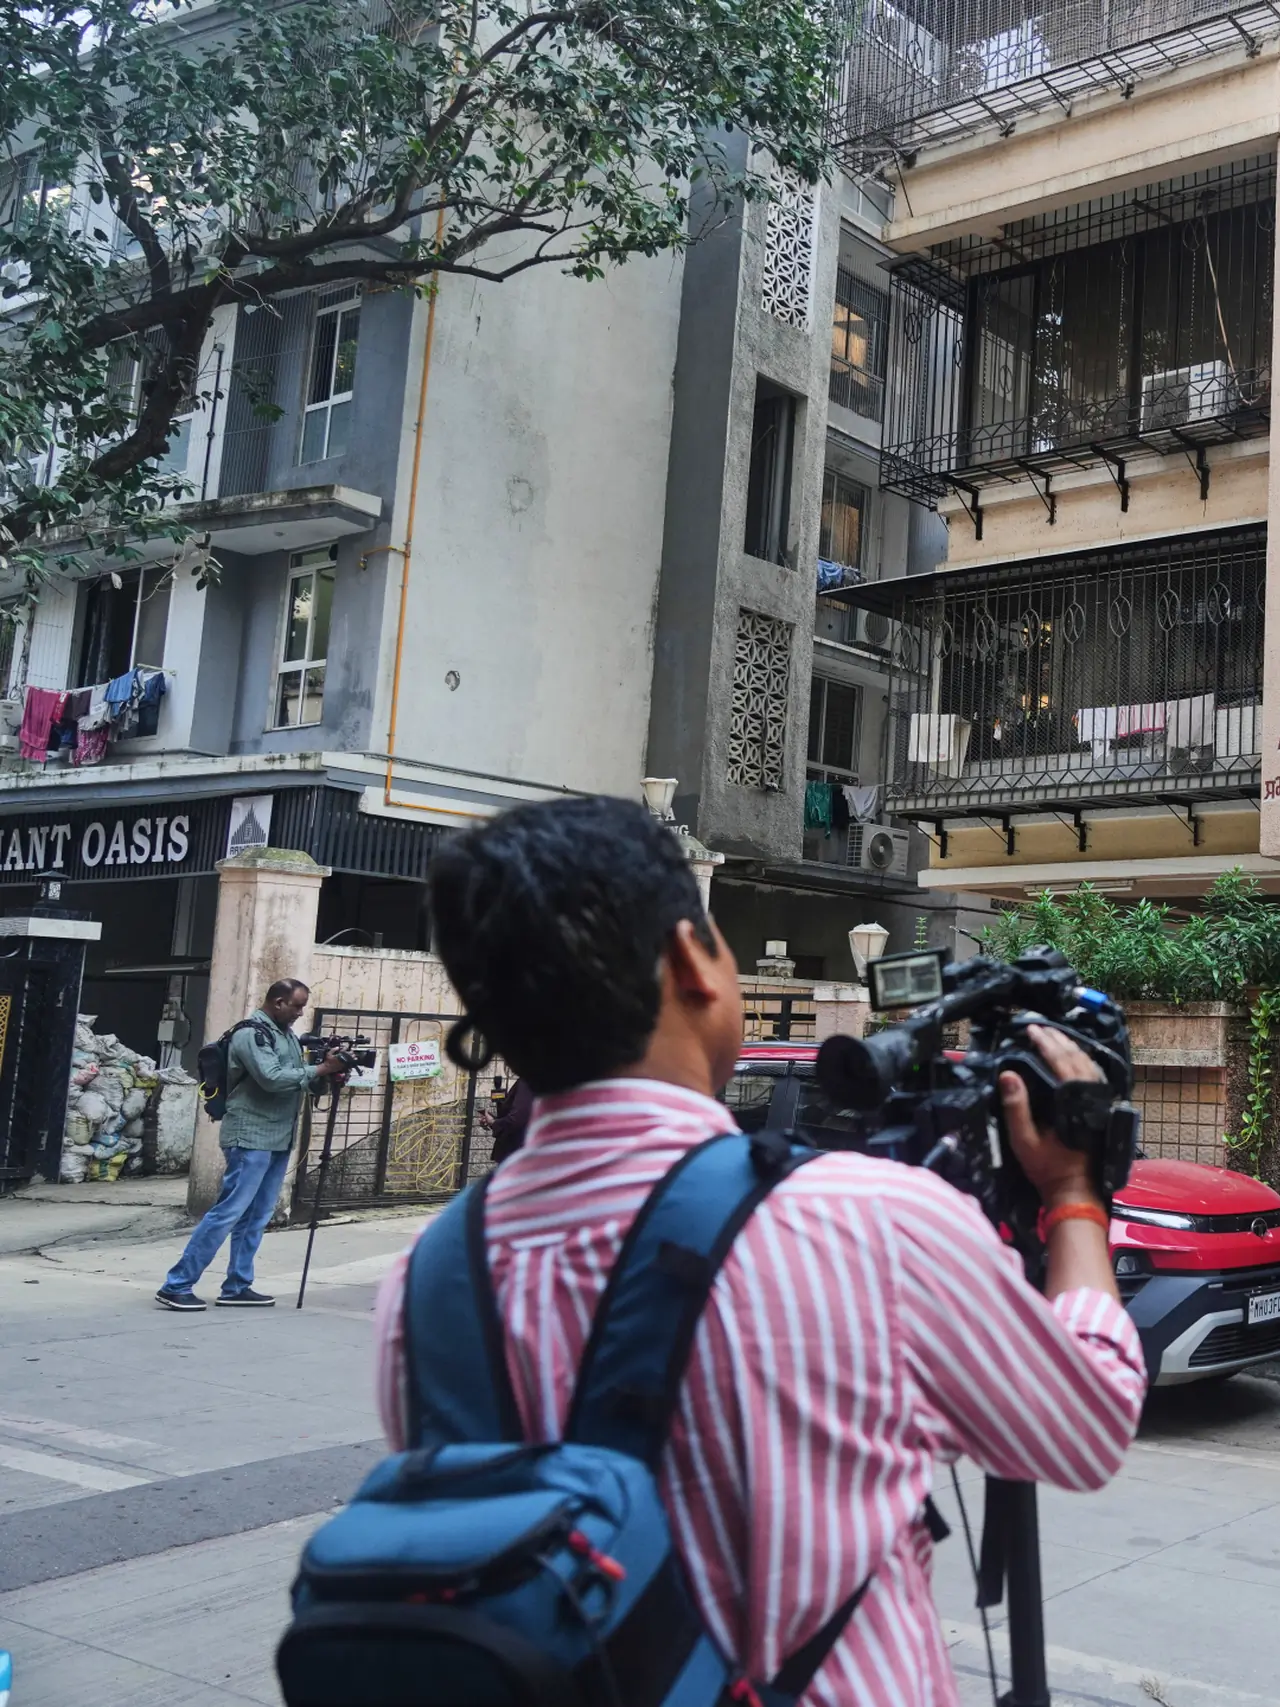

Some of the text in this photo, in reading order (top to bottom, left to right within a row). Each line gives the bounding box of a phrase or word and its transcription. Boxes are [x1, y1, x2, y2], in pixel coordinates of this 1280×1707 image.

[0, 814, 190, 871] ANT OASIS
[407, 1053, 435, 1063] PARKING
